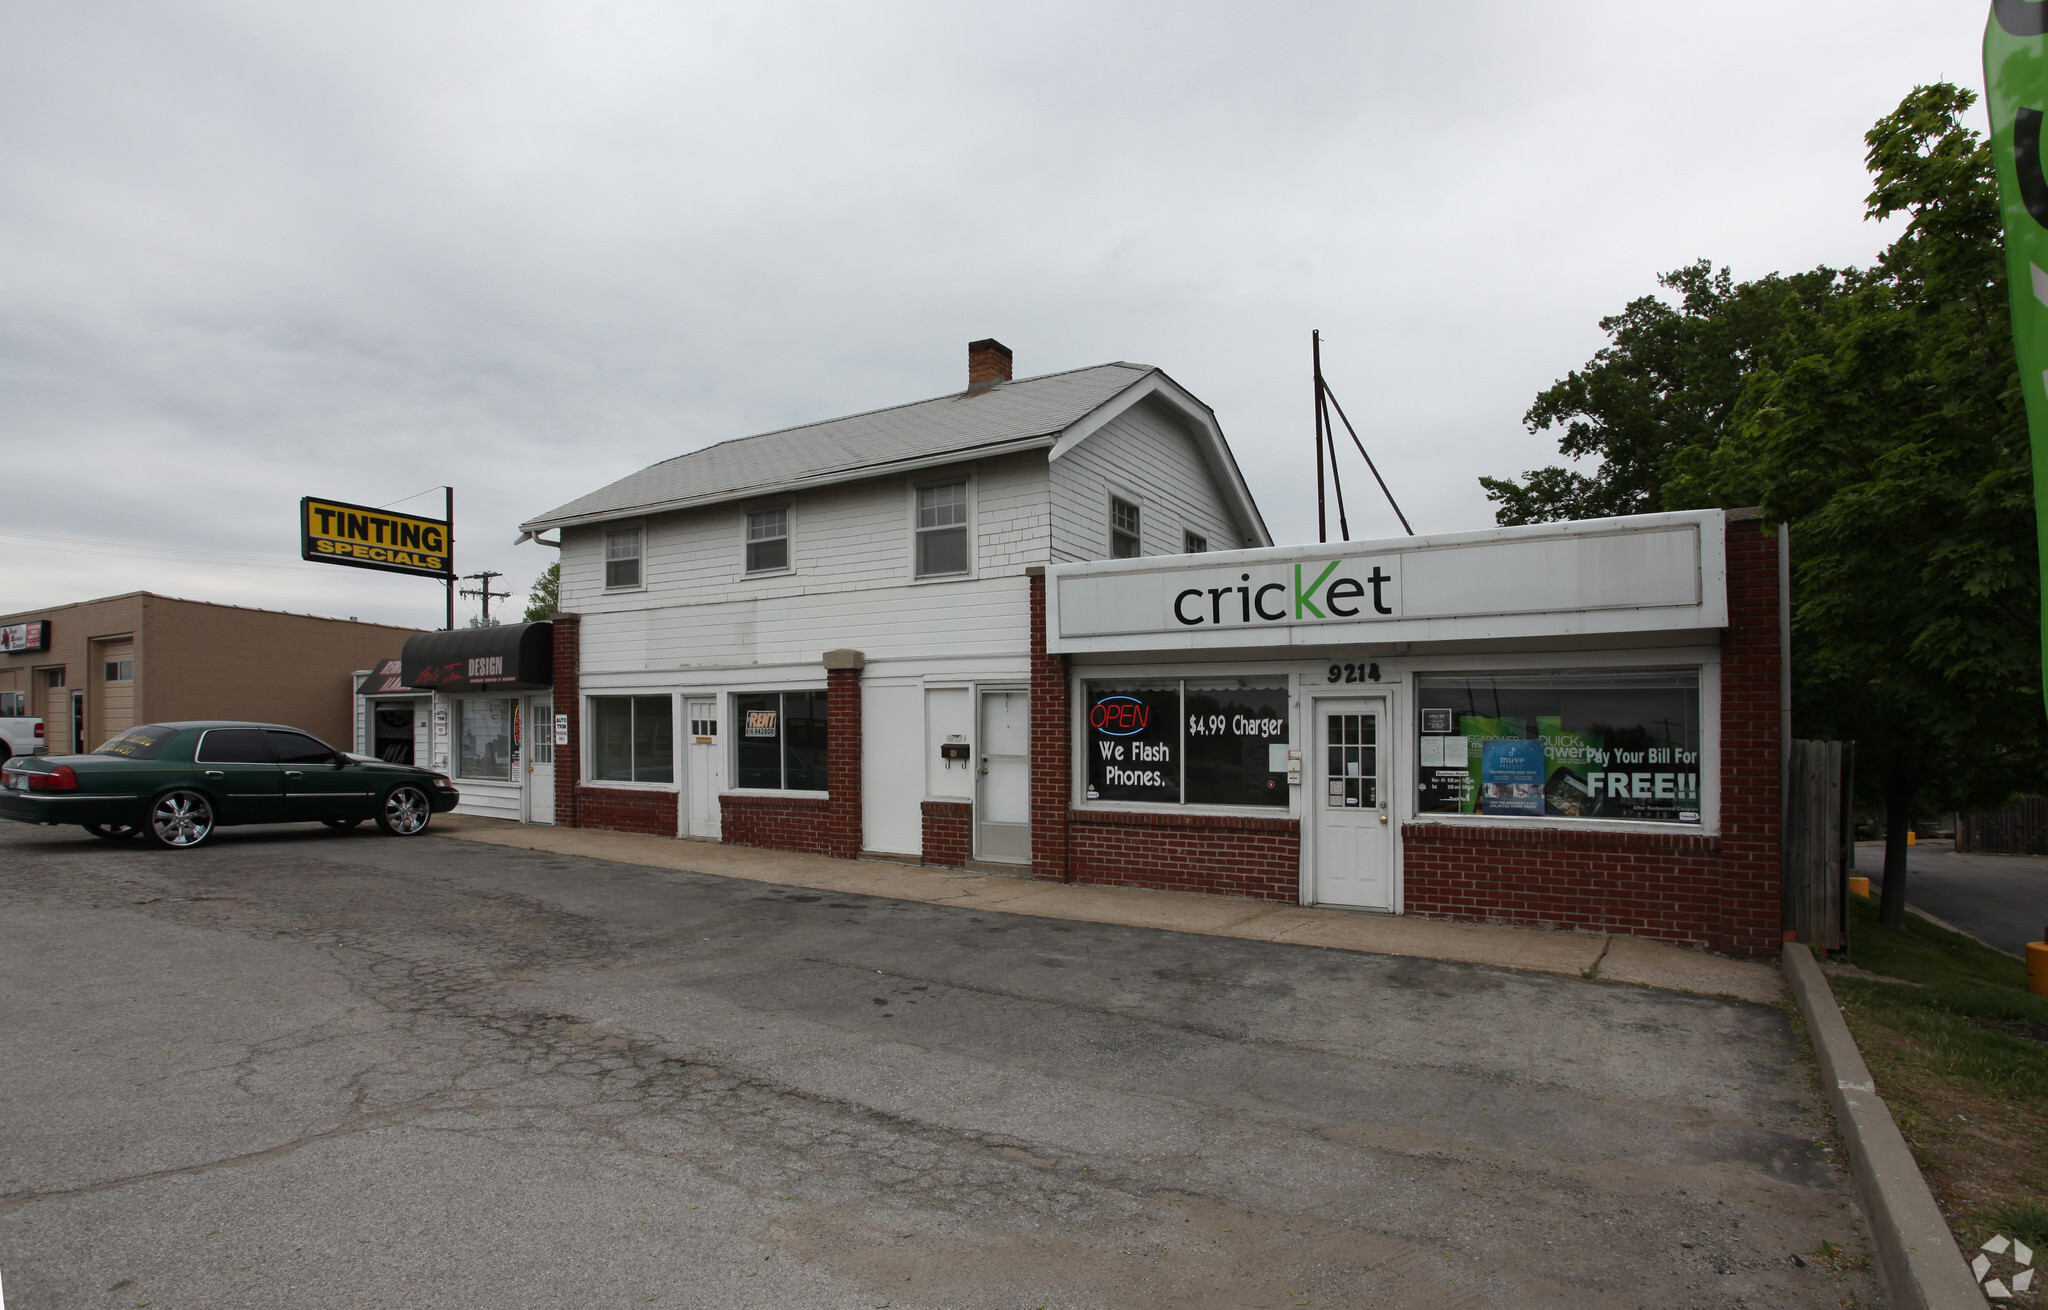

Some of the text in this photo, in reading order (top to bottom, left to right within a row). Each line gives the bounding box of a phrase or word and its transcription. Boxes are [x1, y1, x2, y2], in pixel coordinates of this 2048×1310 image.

[314, 507, 443, 553] TINTING
[316, 540, 442, 569] SPECIALS
[468, 656, 503, 676] DESIGN
[1328, 663, 1381, 683] 9214
[749, 712, 776, 728] RENT
[1090, 704, 1150, 728] OPEN
[1190, 714, 1284, 738] $4.99 Charger
[1099, 741, 1169, 761] We Flash
[1538, 735, 1580, 748] QUICK
[1614, 748, 1645, 763] Your
[1648, 748, 1670, 763] Bill
[1675, 748, 1697, 763] For
[1106, 766, 1166, 787] Phones.
[1587, 772, 1697, 799] FREE!!
